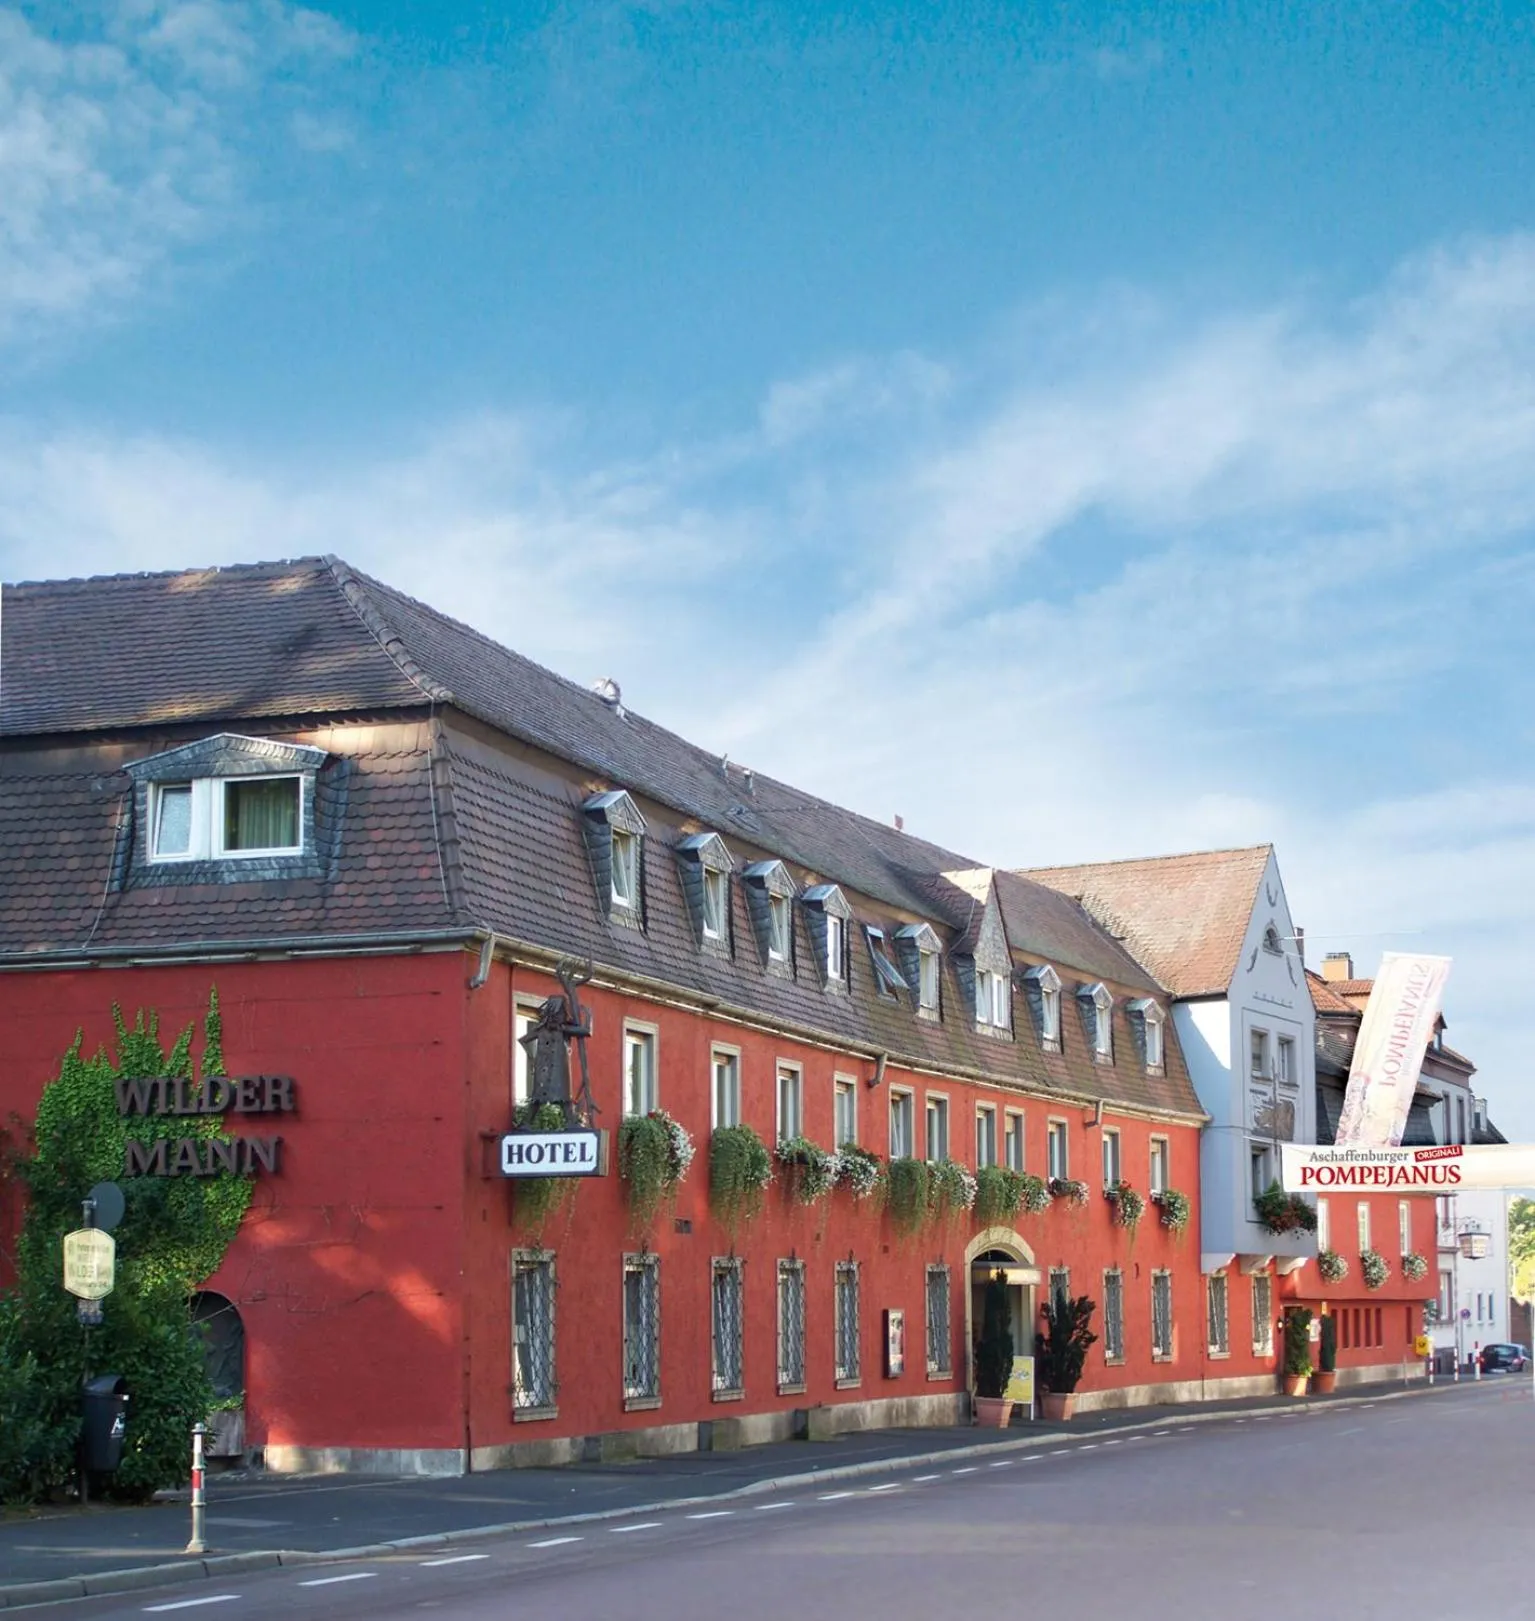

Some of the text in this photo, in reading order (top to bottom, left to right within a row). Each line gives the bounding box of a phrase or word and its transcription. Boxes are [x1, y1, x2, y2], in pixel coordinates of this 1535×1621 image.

[114, 1075, 296, 1115] WILDER
[124, 1135, 284, 1177] MANN
[506, 1141, 594, 1165] HOTEL
[1309, 1150, 1409, 1163] Aschaffenburger
[1300, 1165, 1462, 1187] POMPEJANUS
